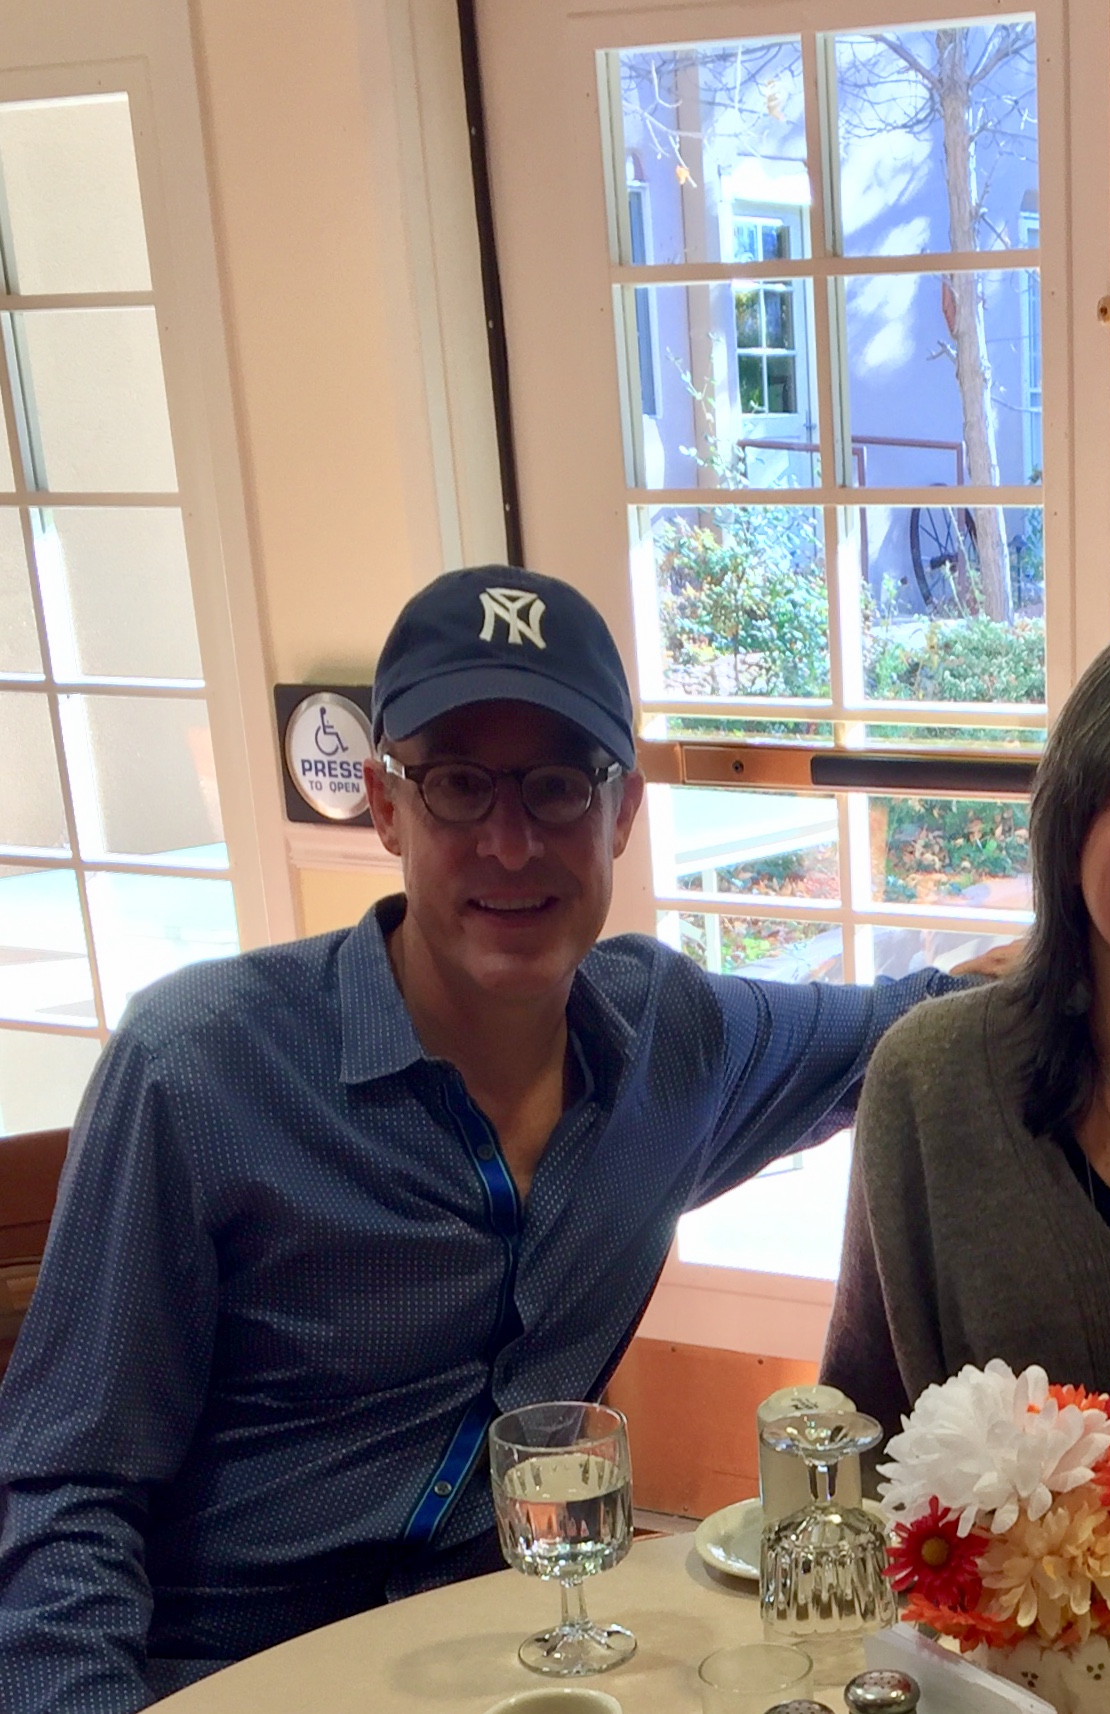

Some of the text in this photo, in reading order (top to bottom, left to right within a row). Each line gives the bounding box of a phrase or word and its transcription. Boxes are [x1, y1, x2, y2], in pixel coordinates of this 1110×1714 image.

[479, 587, 547, 650] NY
[301, 759, 363, 779] PRESS
[309, 780, 323, 791] TO
